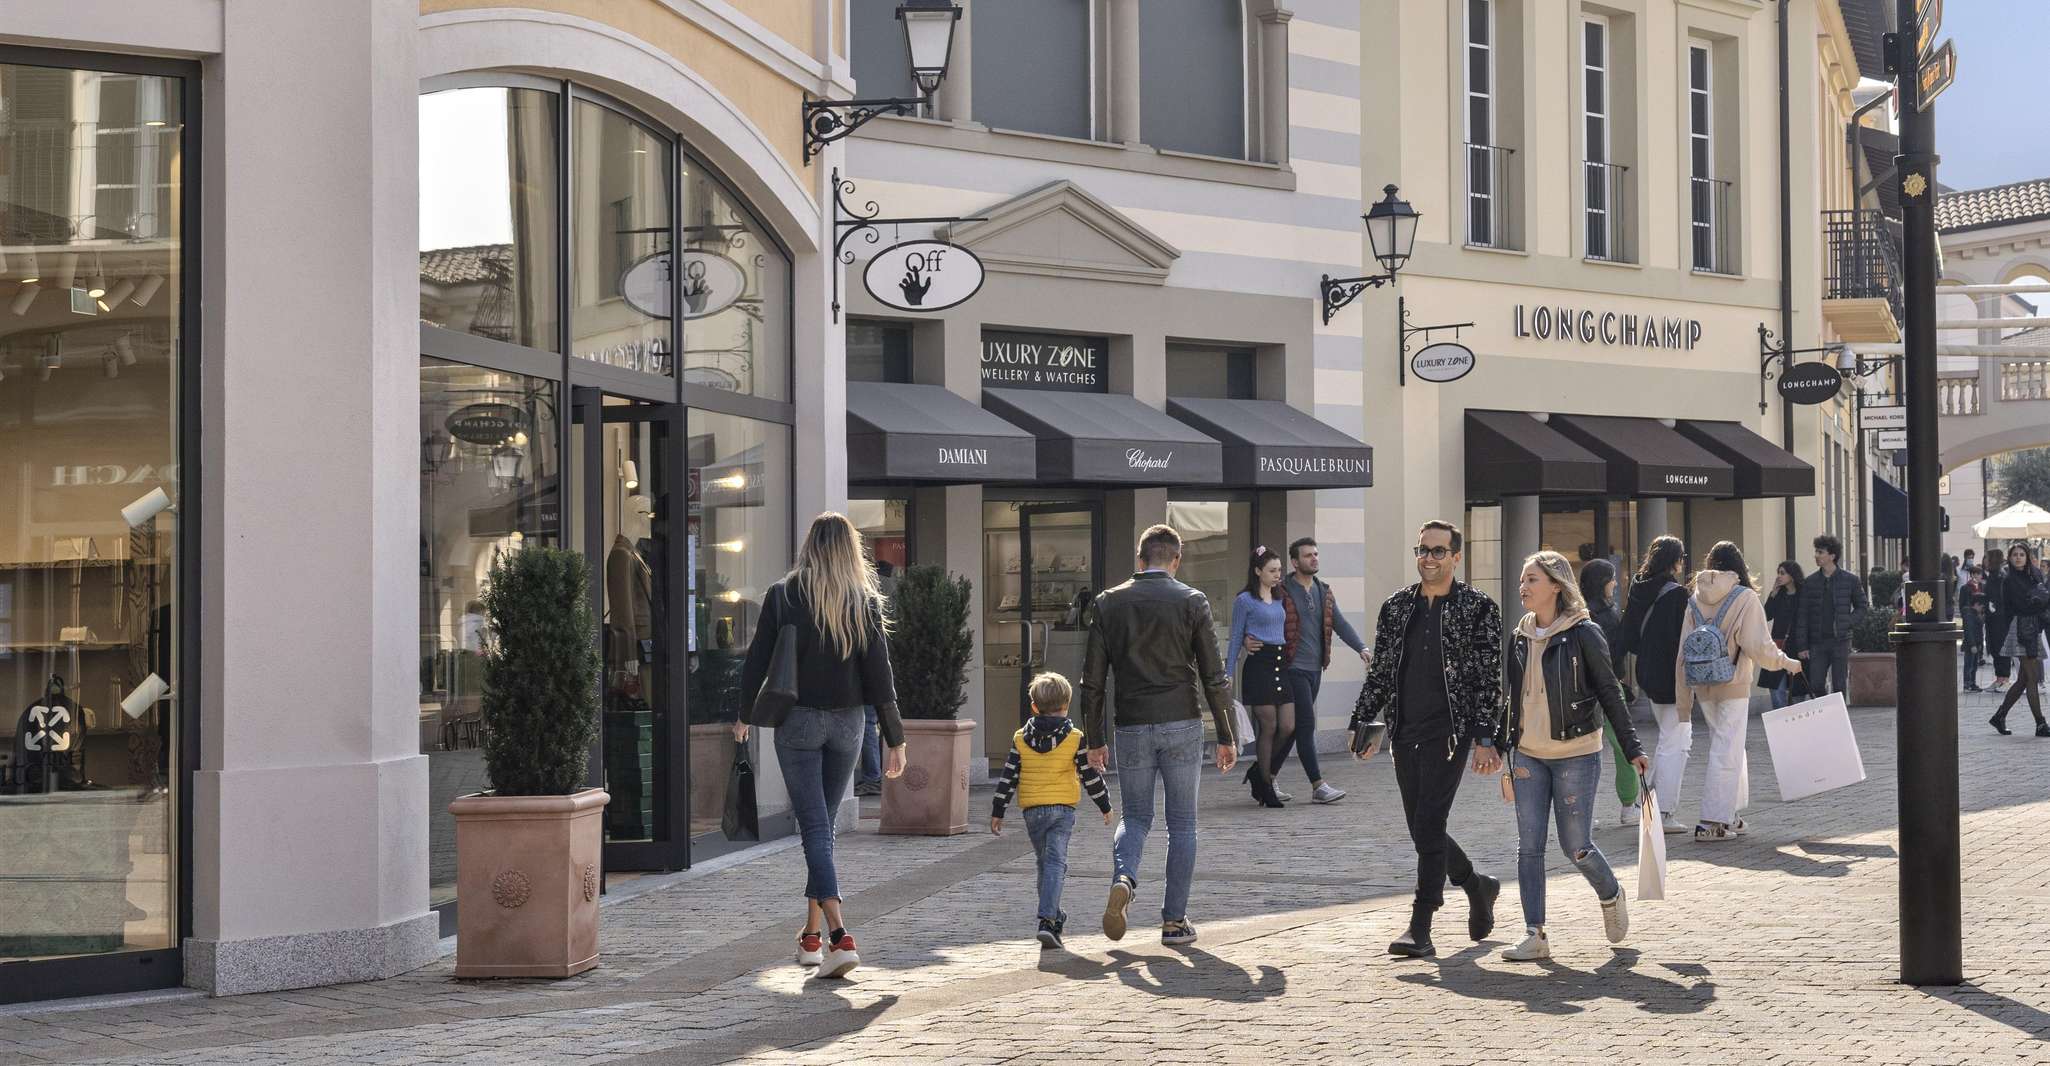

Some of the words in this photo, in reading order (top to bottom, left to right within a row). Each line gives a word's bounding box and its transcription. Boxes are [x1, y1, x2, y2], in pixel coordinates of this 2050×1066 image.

[905, 250, 946, 272] Off
[1515, 304, 1702, 350] LONGCHAMP
[1047, 345, 1096, 368] ZONE
[1416, 358, 1446, 368] LUXURY
[1447, 356, 1469, 365] ZONE
[1034, 370, 1042, 382] &
[1046, 371, 1096, 385] WATCHES
[1783, 378, 1836, 389] LONGCHAMP
[938, 448, 987, 464] DAMIANI
[1125, 448, 1173, 472] Chopard
[1665, 474, 1709, 485] LONGCHAMP
